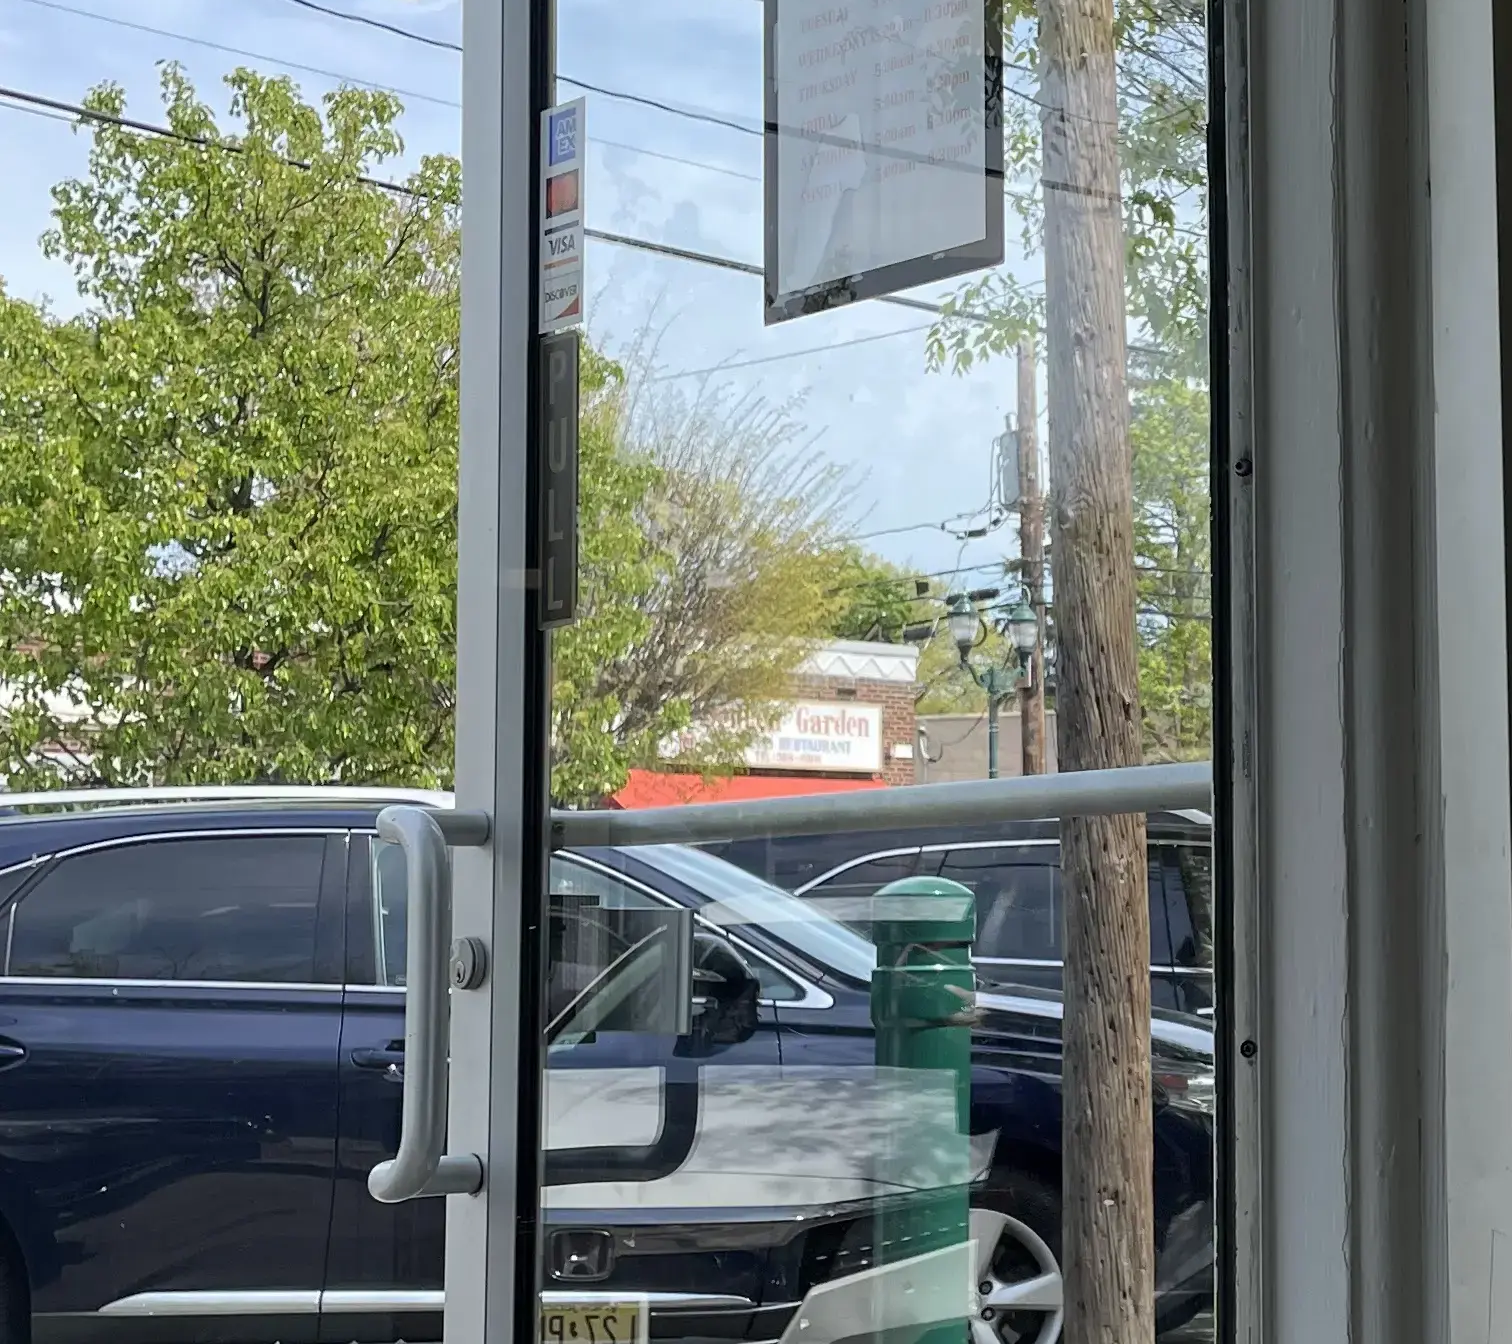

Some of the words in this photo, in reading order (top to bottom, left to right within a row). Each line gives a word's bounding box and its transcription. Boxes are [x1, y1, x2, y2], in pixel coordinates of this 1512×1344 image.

[548, 234, 576, 256] VISA
[545, 284, 577, 304] DISCOVER
[547, 350, 567, 611] PULL
[795, 706, 870, 738] Garden
